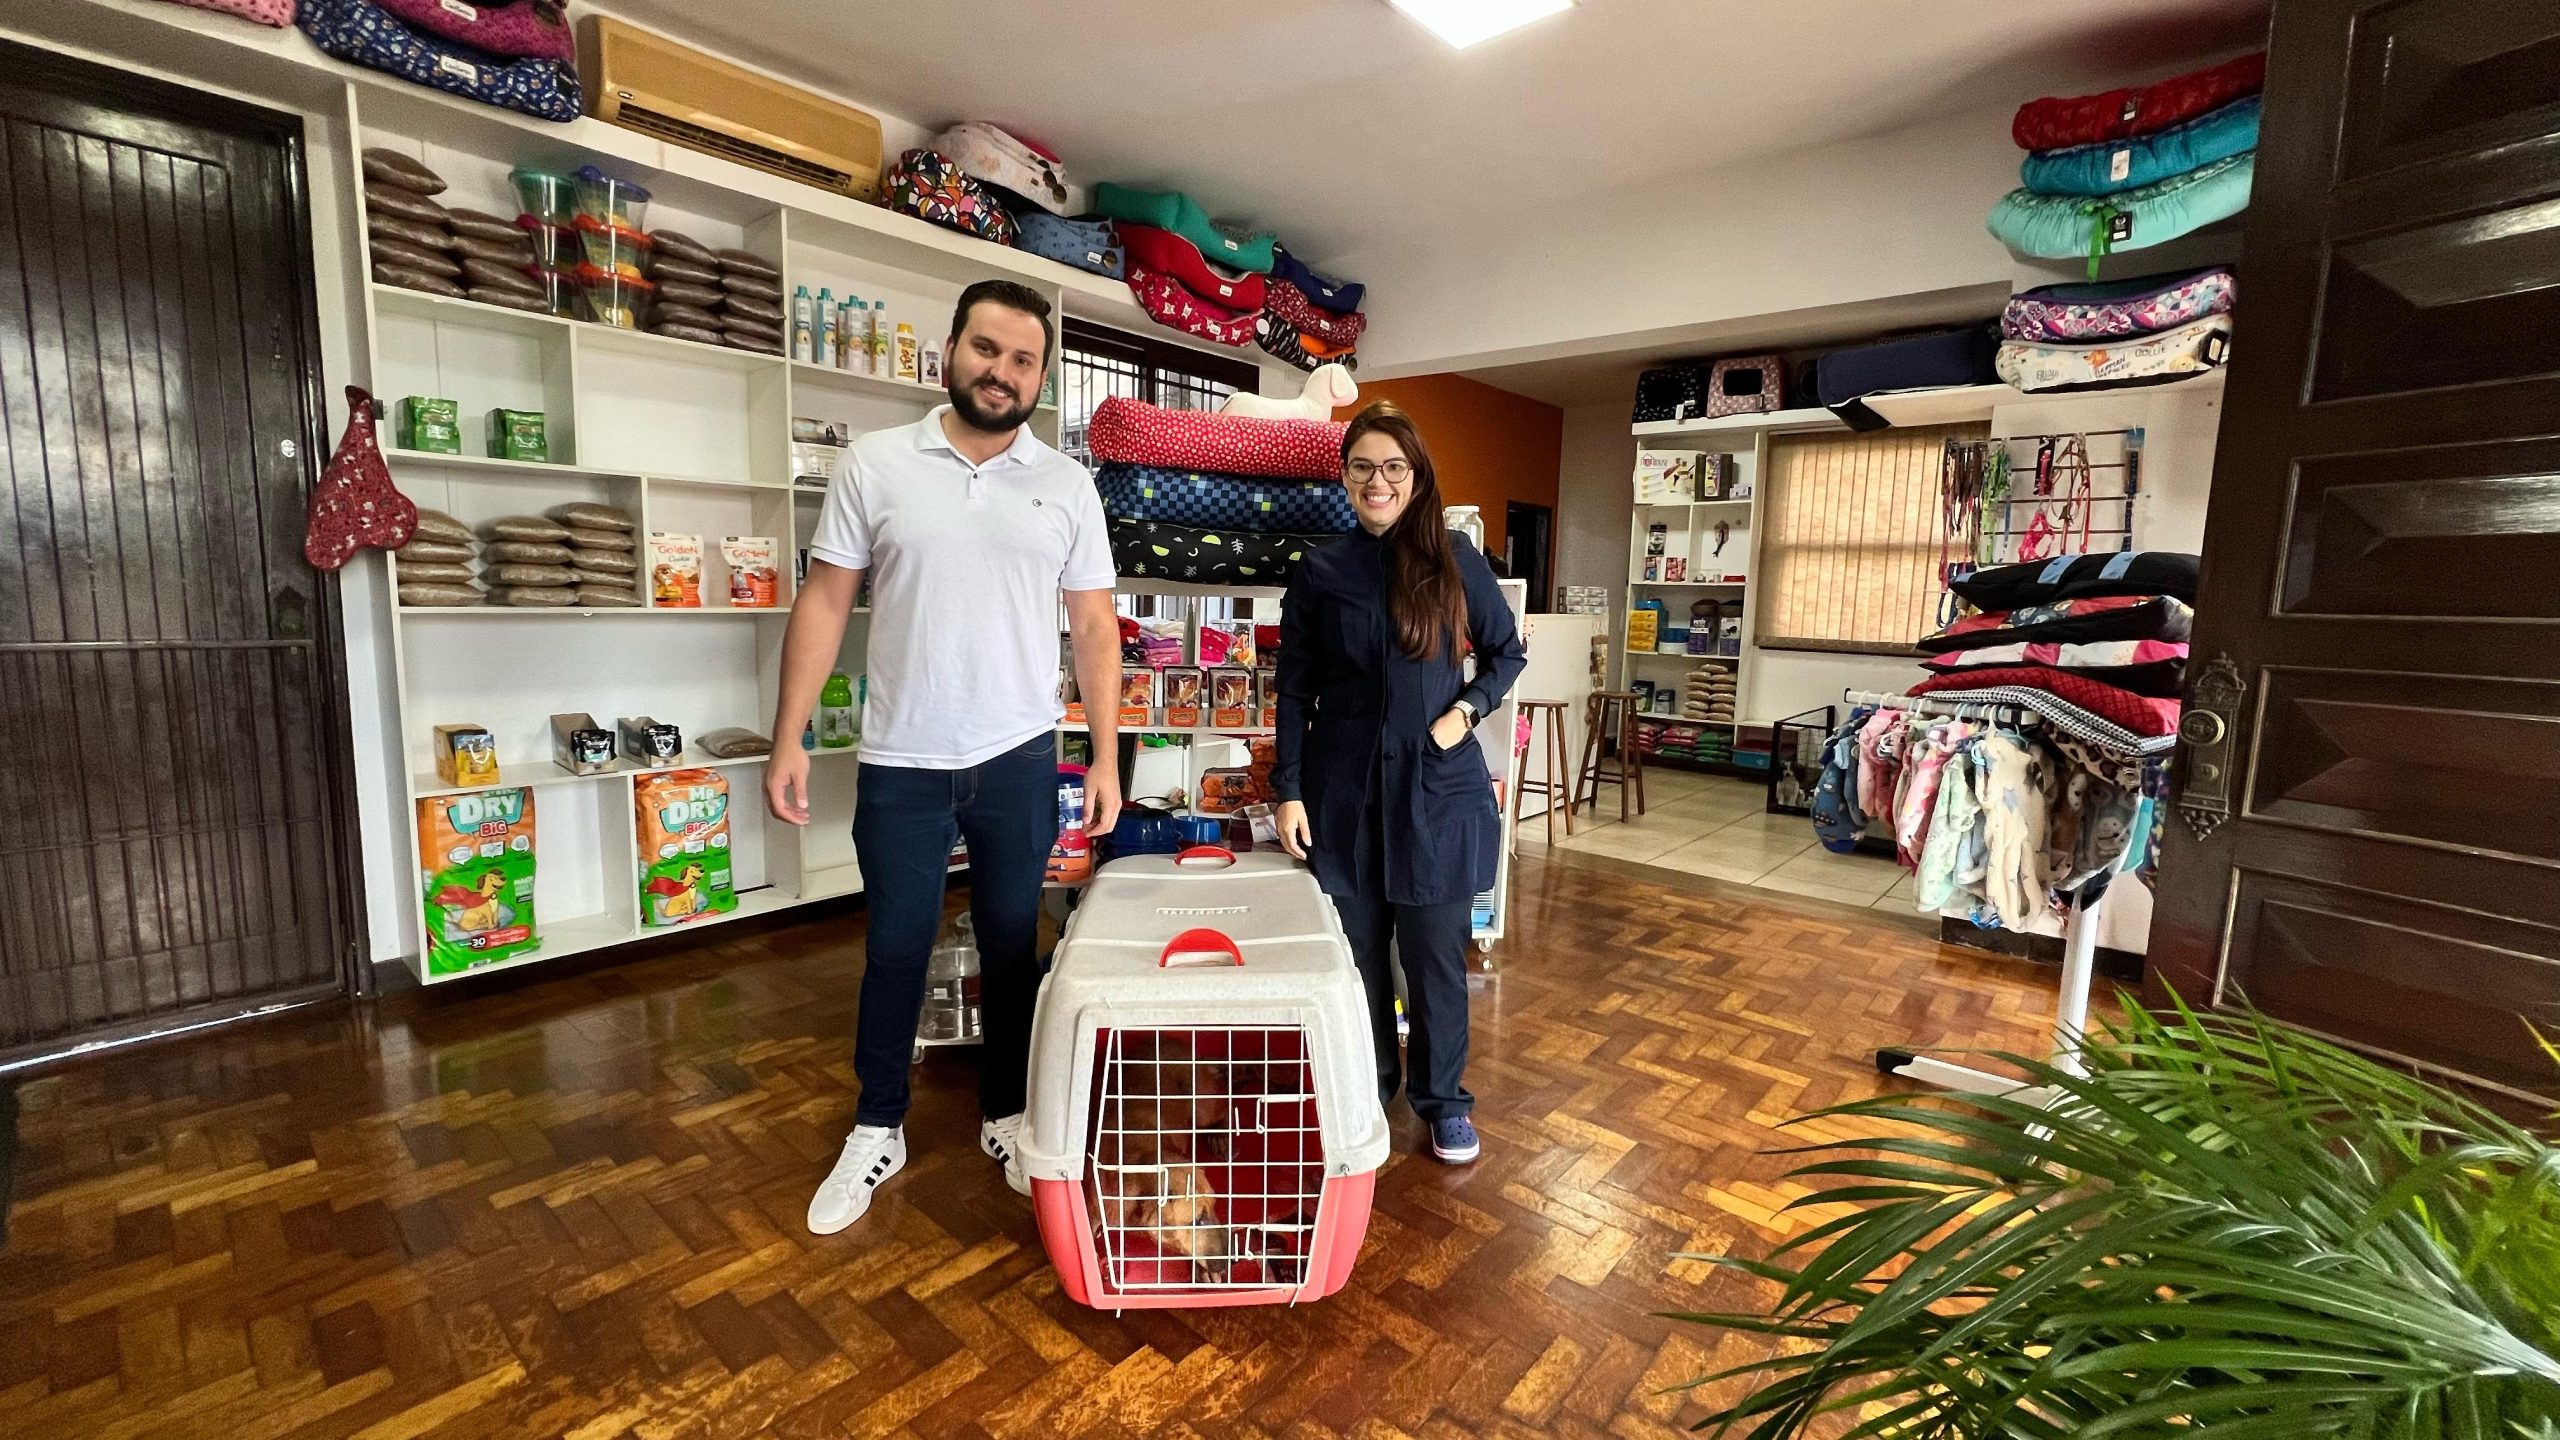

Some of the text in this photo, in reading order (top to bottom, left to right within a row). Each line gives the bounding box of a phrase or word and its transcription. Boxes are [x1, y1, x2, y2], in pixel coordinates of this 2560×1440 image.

[458, 794, 518, 825] DRY
[668, 800, 721, 825] DRY
[471, 937, 486, 947] 30
